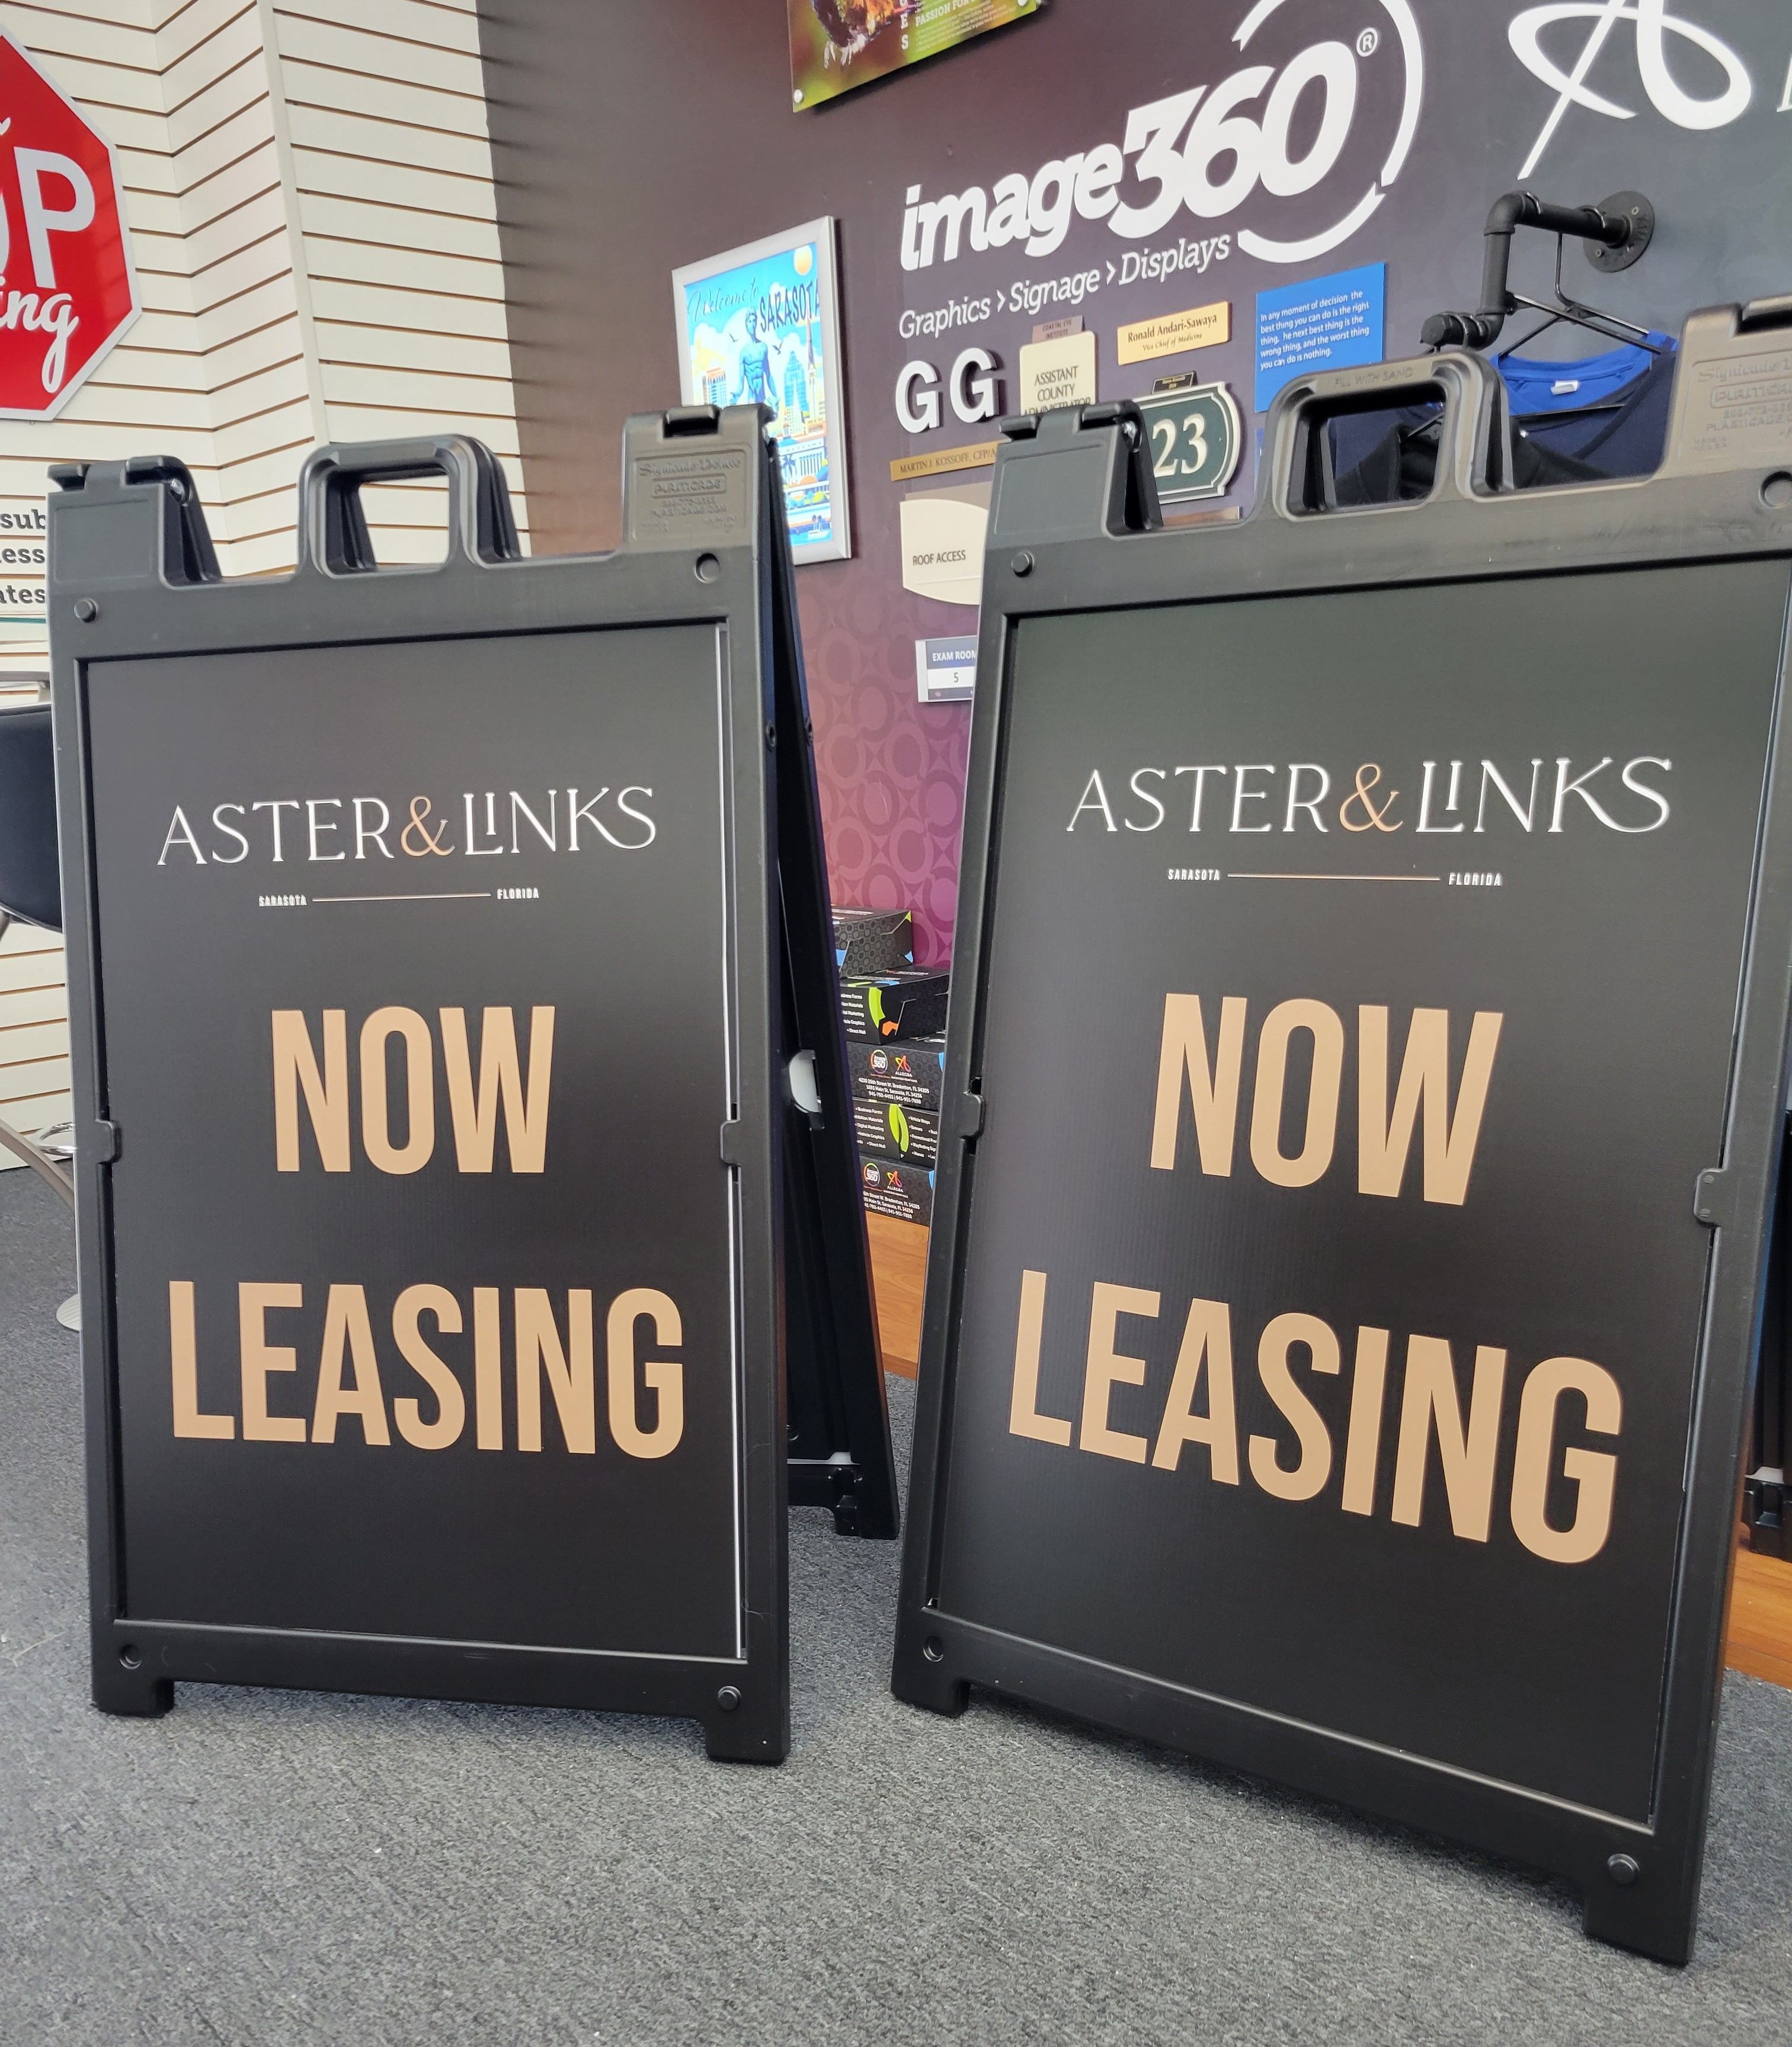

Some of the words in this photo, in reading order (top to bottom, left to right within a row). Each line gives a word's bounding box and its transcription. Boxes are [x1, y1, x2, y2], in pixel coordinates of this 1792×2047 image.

[916, 2, 951, 27] PASSION
[687, 288, 745, 322] Welcome
[750, 277, 759, 302] to
[898, 296, 991, 339] Graphics
[1009, 268, 1100, 315] Signage
[1119, 234, 1230, 286] Displays
[760, 278, 820, 333] SARASOTA
[1260, 314, 1267, 322] In
[1268, 312, 1280, 321] any
[1282, 305, 1310, 317] moment
[1311, 300, 1319, 309] of
[1320, 294, 1348, 307] decision
[1351, 290, 1363, 300] the
[1260, 324, 1274, 334] best
[1276, 320, 1293, 330] thing
[1295, 318, 1307, 328] you
[1308, 314, 1320, 322] can
[1322, 310, 1331, 319] do
[1333, 309, 1337, 317] is
[1339, 305, 1351, 315] the
[1352, 301, 1369, 313] right
[1128, 326, 1155, 343] Ronald
[1157, 314, 1217, 337] Andari-Sawaya
[1283, 332, 1291, 341] he
[1293, 328, 1308, 338] next
[1309, 325, 1323, 334] best
[1325, 320, 1343, 331] thing
[1345, 318, 1350, 326] is
[1351, 315, 1363, 325] the
[1156, 339, 1169, 350] Chief
[1171, 337, 1176, 347] of
[1177, 333, 1202, 343] Medicine
[1260, 348, 1281, 358] wrong
[1303, 338, 1316, 348] and
[1317, 335, 1329, 345] the
[1330, 331, 1349, 342] worst
[1351, 326, 1369, 338] thing
[1260, 361, 1272, 371] you
[1274, 358, 1285, 366] can
[1287, 355, 1295, 364] do
[1303, 347, 1332, 360] nothing.
[1035, 366, 1079, 386] ASSISTANT
[1038, 383, 1075, 402] COUNTY
[1152, 413, 1208, 478] 23
[900, 459, 927, 474] MARTIN
[0, 548, 45, 564] ess
[913, 553, 934, 566] ROOF
[936, 549, 966, 563] ACCESS
[933, 651, 953, 662] EXAM
[955, 649, 976, 660] ROOM
[953, 672, 959, 683] 5
[1167, 868, 1221, 881] SARASOTA
[1448, 872, 1502, 886] FLORIDA
[258, 894, 308, 907] SARASOTA
[497, 887, 539, 900] FLORIDA
[272, 1005, 555, 1175] NOW
[1151, 992, 1504, 1206] NOW
[169, 1281, 684, 1459] LEASING
[1010, 1270, 1623, 1564] LEASING
